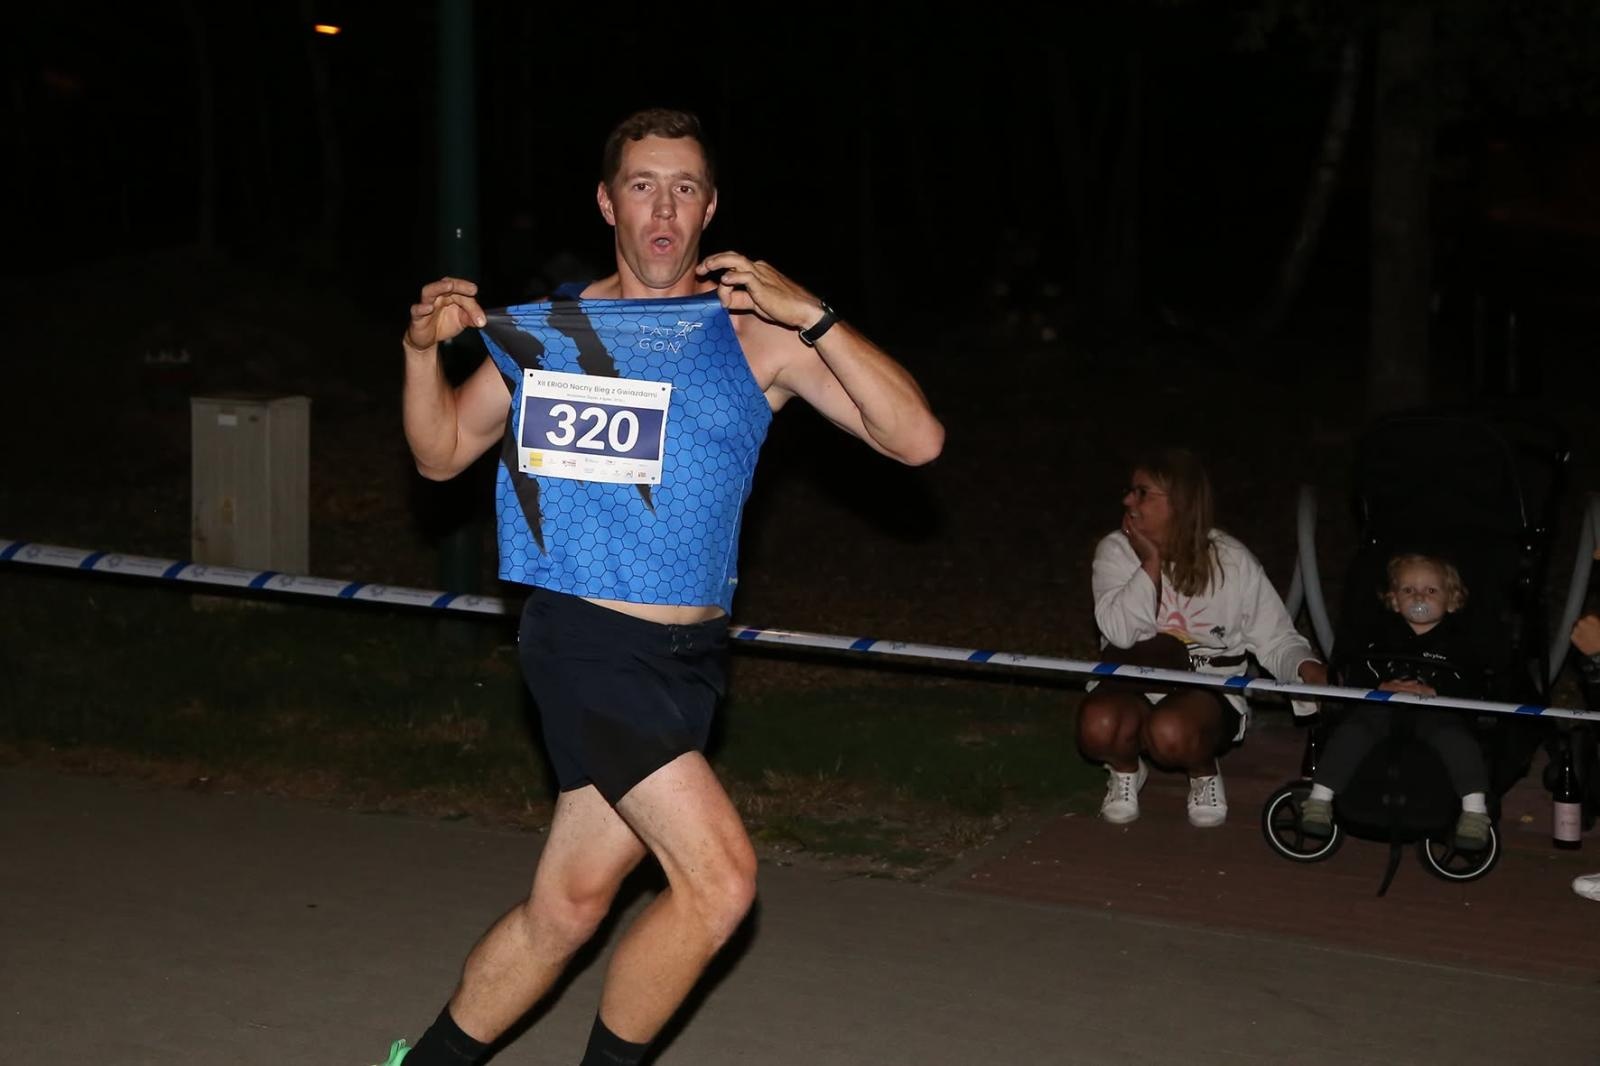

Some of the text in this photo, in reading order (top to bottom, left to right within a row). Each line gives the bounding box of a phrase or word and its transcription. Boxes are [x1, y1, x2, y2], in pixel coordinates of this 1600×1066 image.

[639, 338, 681, 354] GON
[594, 386, 610, 395] Bieg
[616, 388, 658, 399] Gwiazdami
[546, 404, 640, 453] 320
